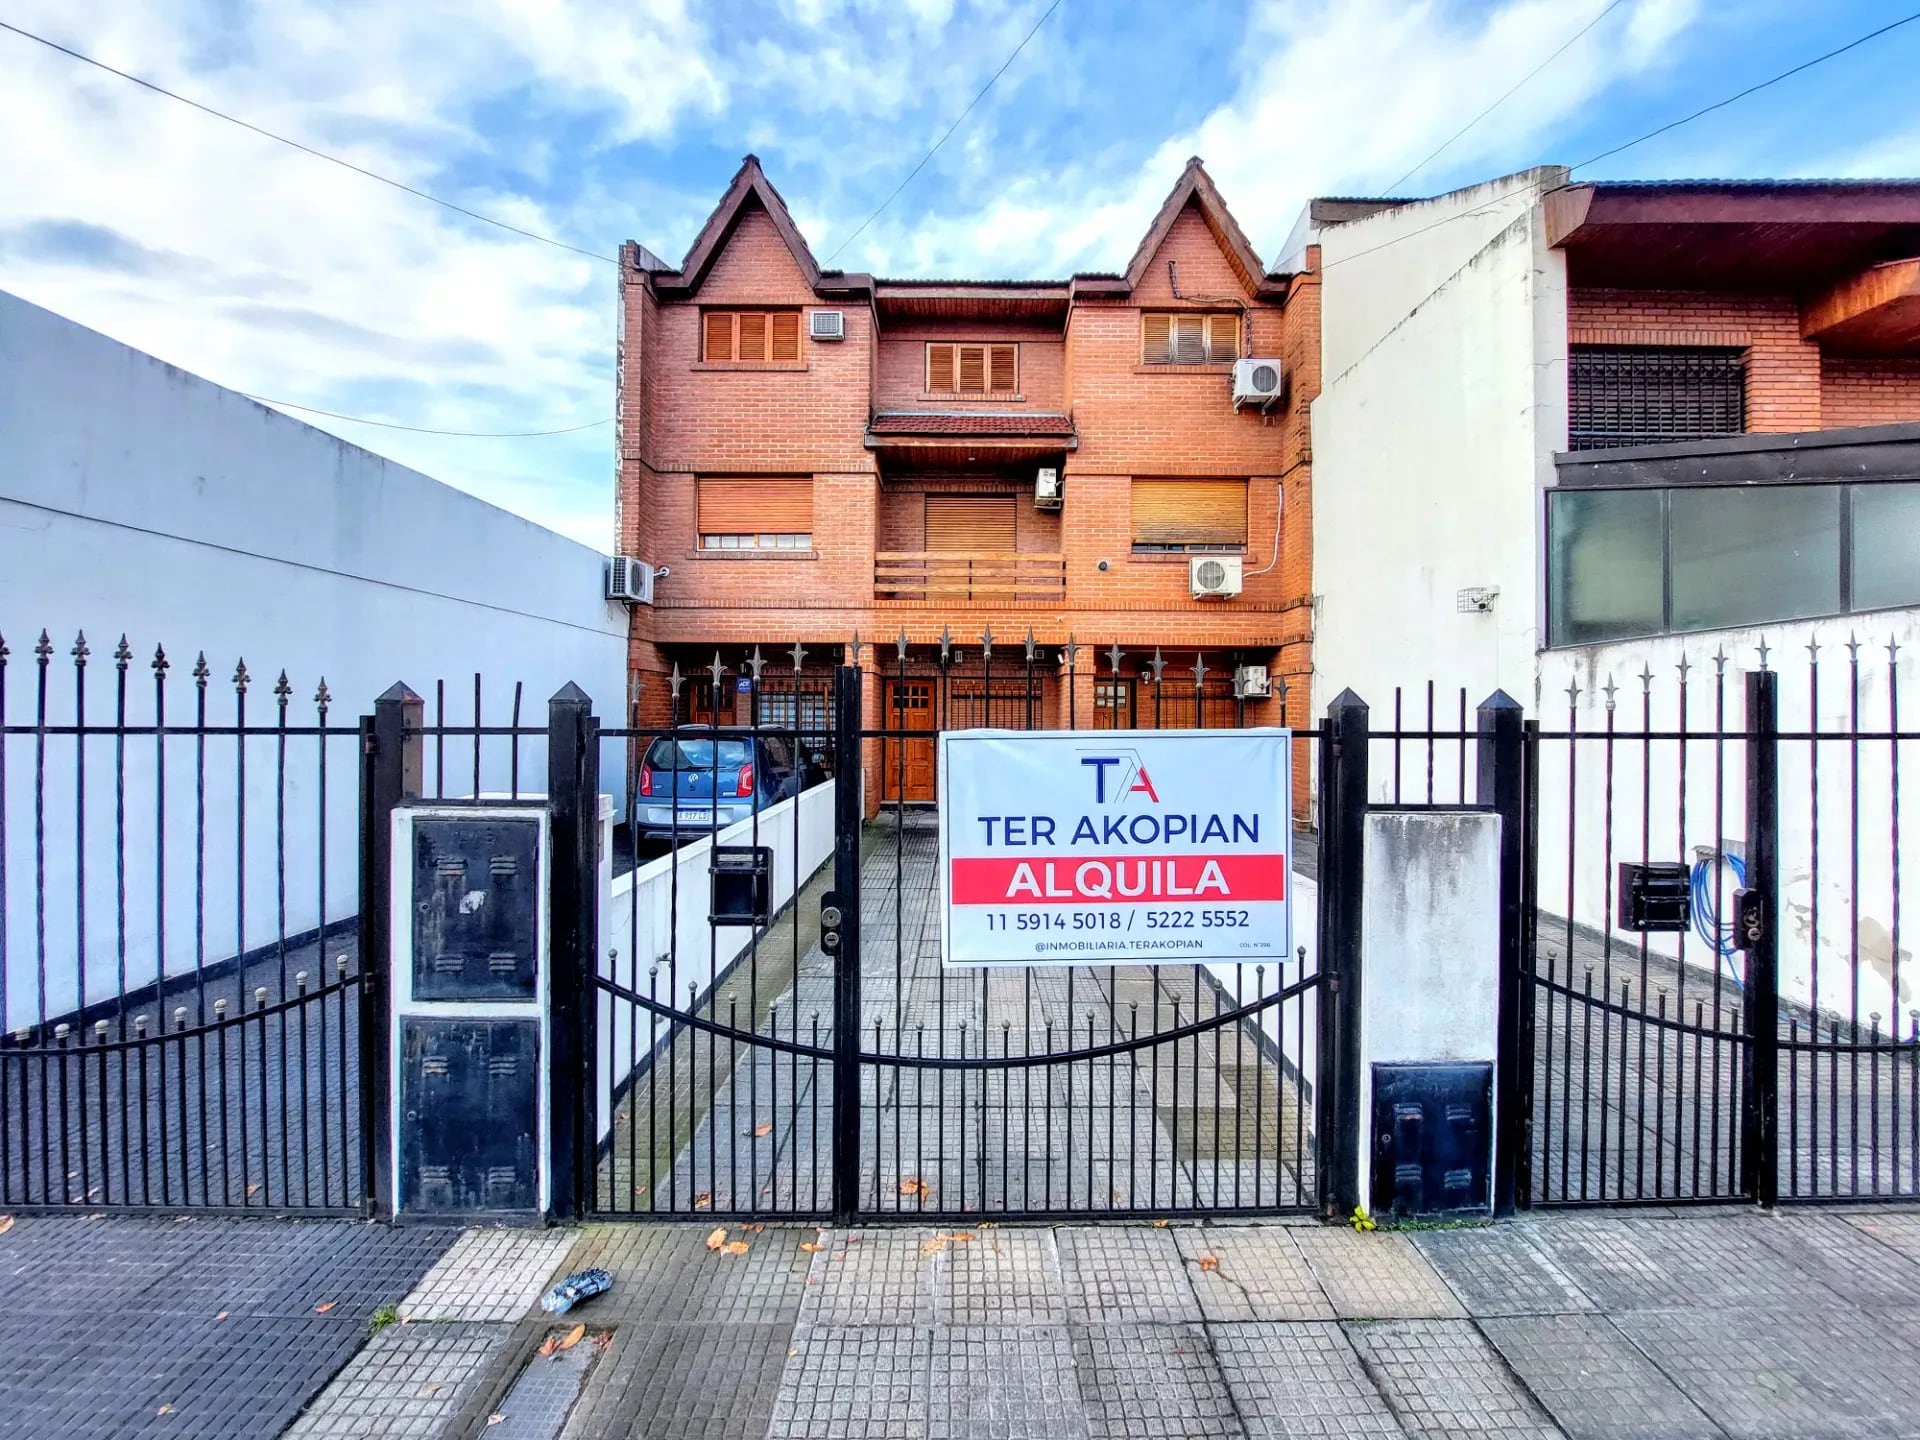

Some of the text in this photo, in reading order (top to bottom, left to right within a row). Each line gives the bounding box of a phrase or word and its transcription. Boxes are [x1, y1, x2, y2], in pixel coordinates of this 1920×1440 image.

[977, 813, 1259, 846] TER AKOPIAN
[1005, 860, 1231, 899] ALQUILA
[986, 909, 1250, 931] 11 5914 5018 / 5222 5552
[1035, 939, 1203, 952] @INMOBILIARIA.TERAKOPIAN
